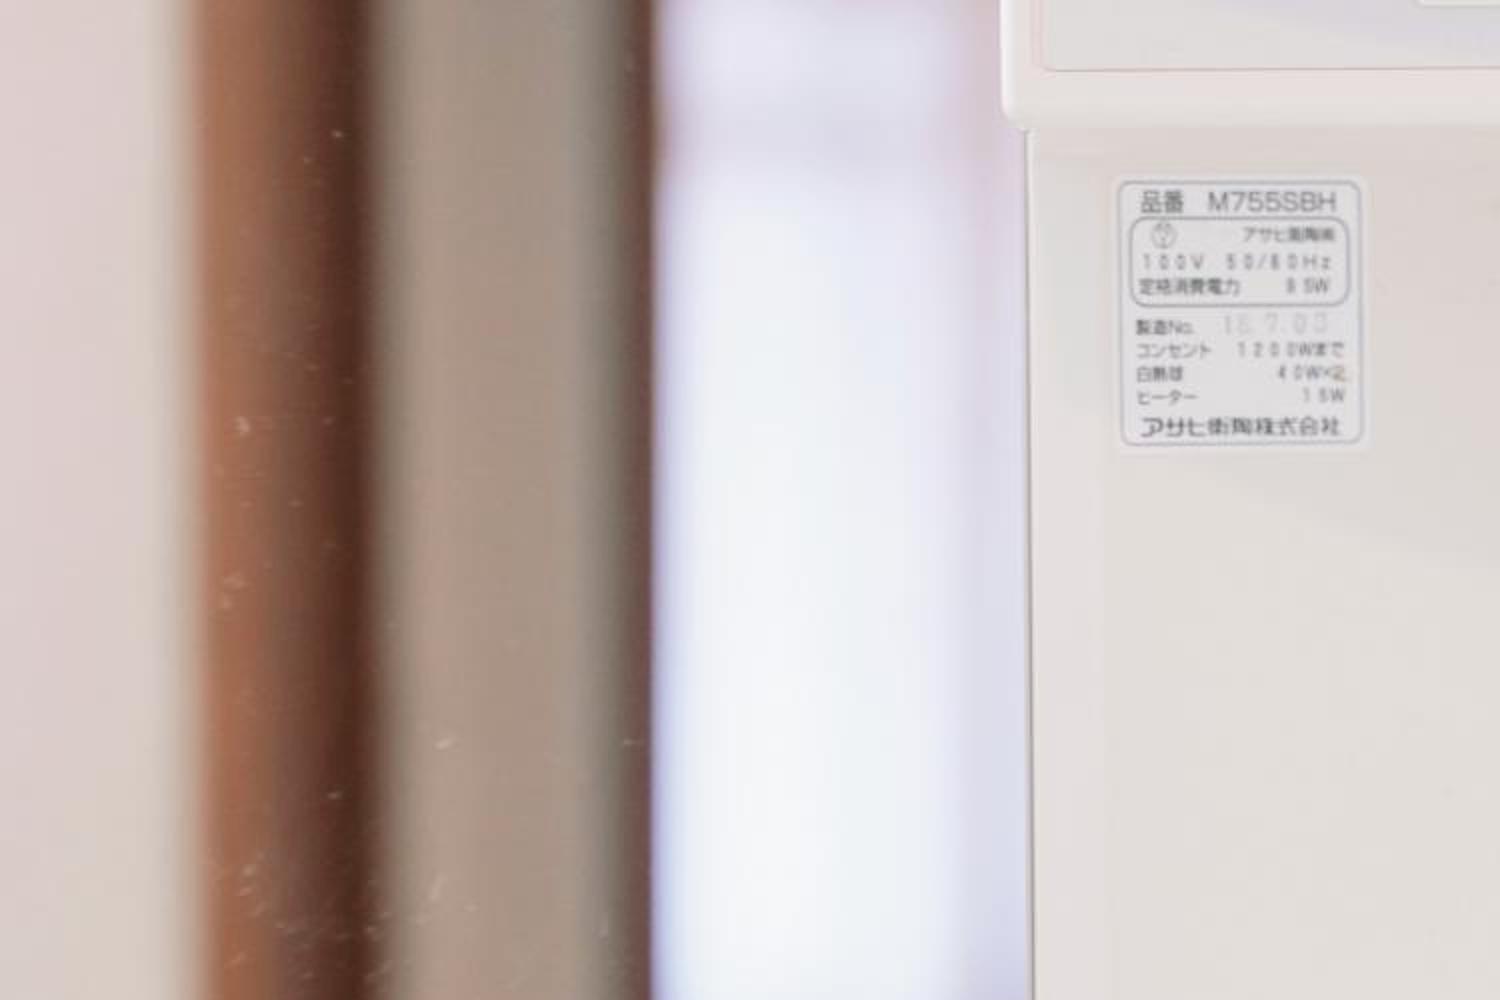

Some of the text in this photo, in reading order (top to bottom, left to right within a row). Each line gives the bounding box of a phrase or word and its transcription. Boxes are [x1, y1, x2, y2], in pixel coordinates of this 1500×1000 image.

[1141, 190, 1336, 213] 品番 M755SBH
[1137, 342, 1212, 359] コンセント
[1137, 390, 1199, 405] ヒーター
[1141, 417, 1340, 437] アサヒ衛陶株式会社
